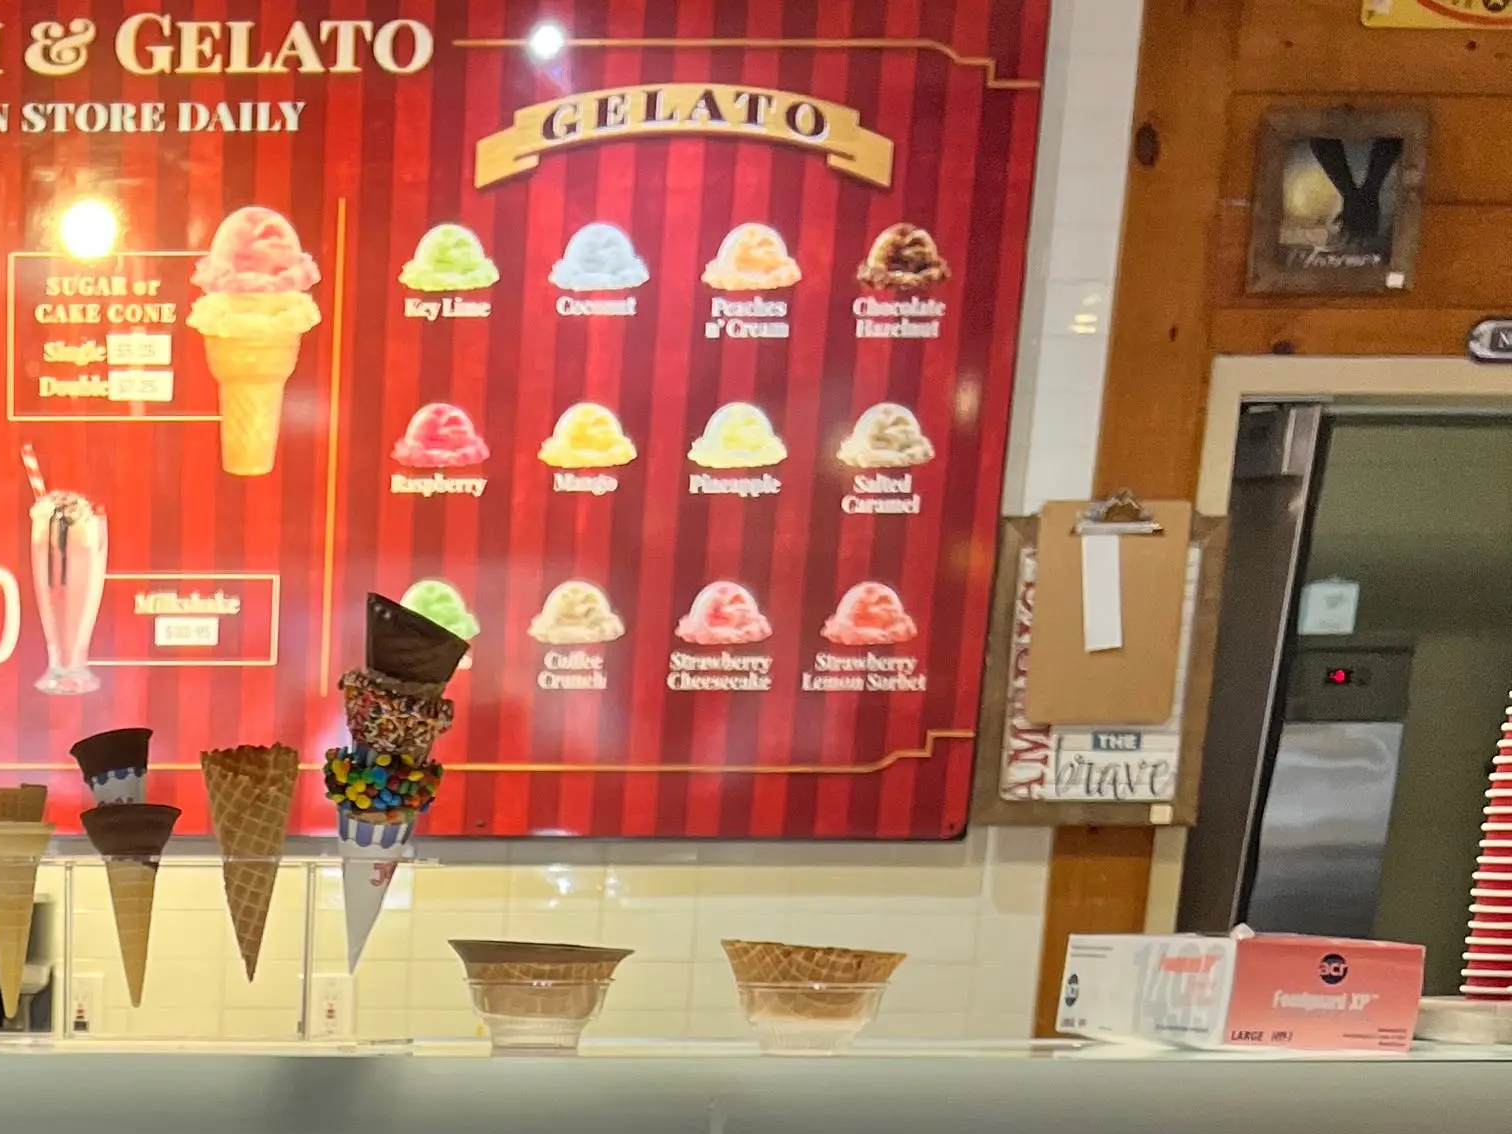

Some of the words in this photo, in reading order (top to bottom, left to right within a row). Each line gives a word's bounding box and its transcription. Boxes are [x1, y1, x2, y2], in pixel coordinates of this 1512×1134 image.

[25, 18, 95, 75] &
[114, 13, 434, 76] GELATO
[21, 102, 165, 133] STORE
[177, 101, 306, 133] DAILY
[541, 88, 829, 142] GELATO
[46, 277, 127, 298] SUGAR
[132, 279, 160, 298] or
[35, 304, 101, 324] CAKE
[106, 304, 177, 324] CONE
[446, 298, 491, 318] Lime
[711, 297, 787, 318] Peaches
[853, 297, 946, 318] Chocolate
[725, 319, 790, 340] Cream
[390, 474, 487, 497] Raspberry
[554, 473, 618, 494] Mango
[689, 473, 782, 496] Pineapple
[853, 473, 912, 494] Salted
[841, 494, 921, 515] Caramel
[133, 591, 240, 615] Milkshake
[543, 652, 604, 671] Coffee
[669, 652, 773, 675] Strawberry
[814, 652, 918, 675] Strawberry
[866, 671, 926, 691] Sorbet
[1097, 734, 1137, 749] THE
[1231, 1030, 1264, 1042] LARGE
